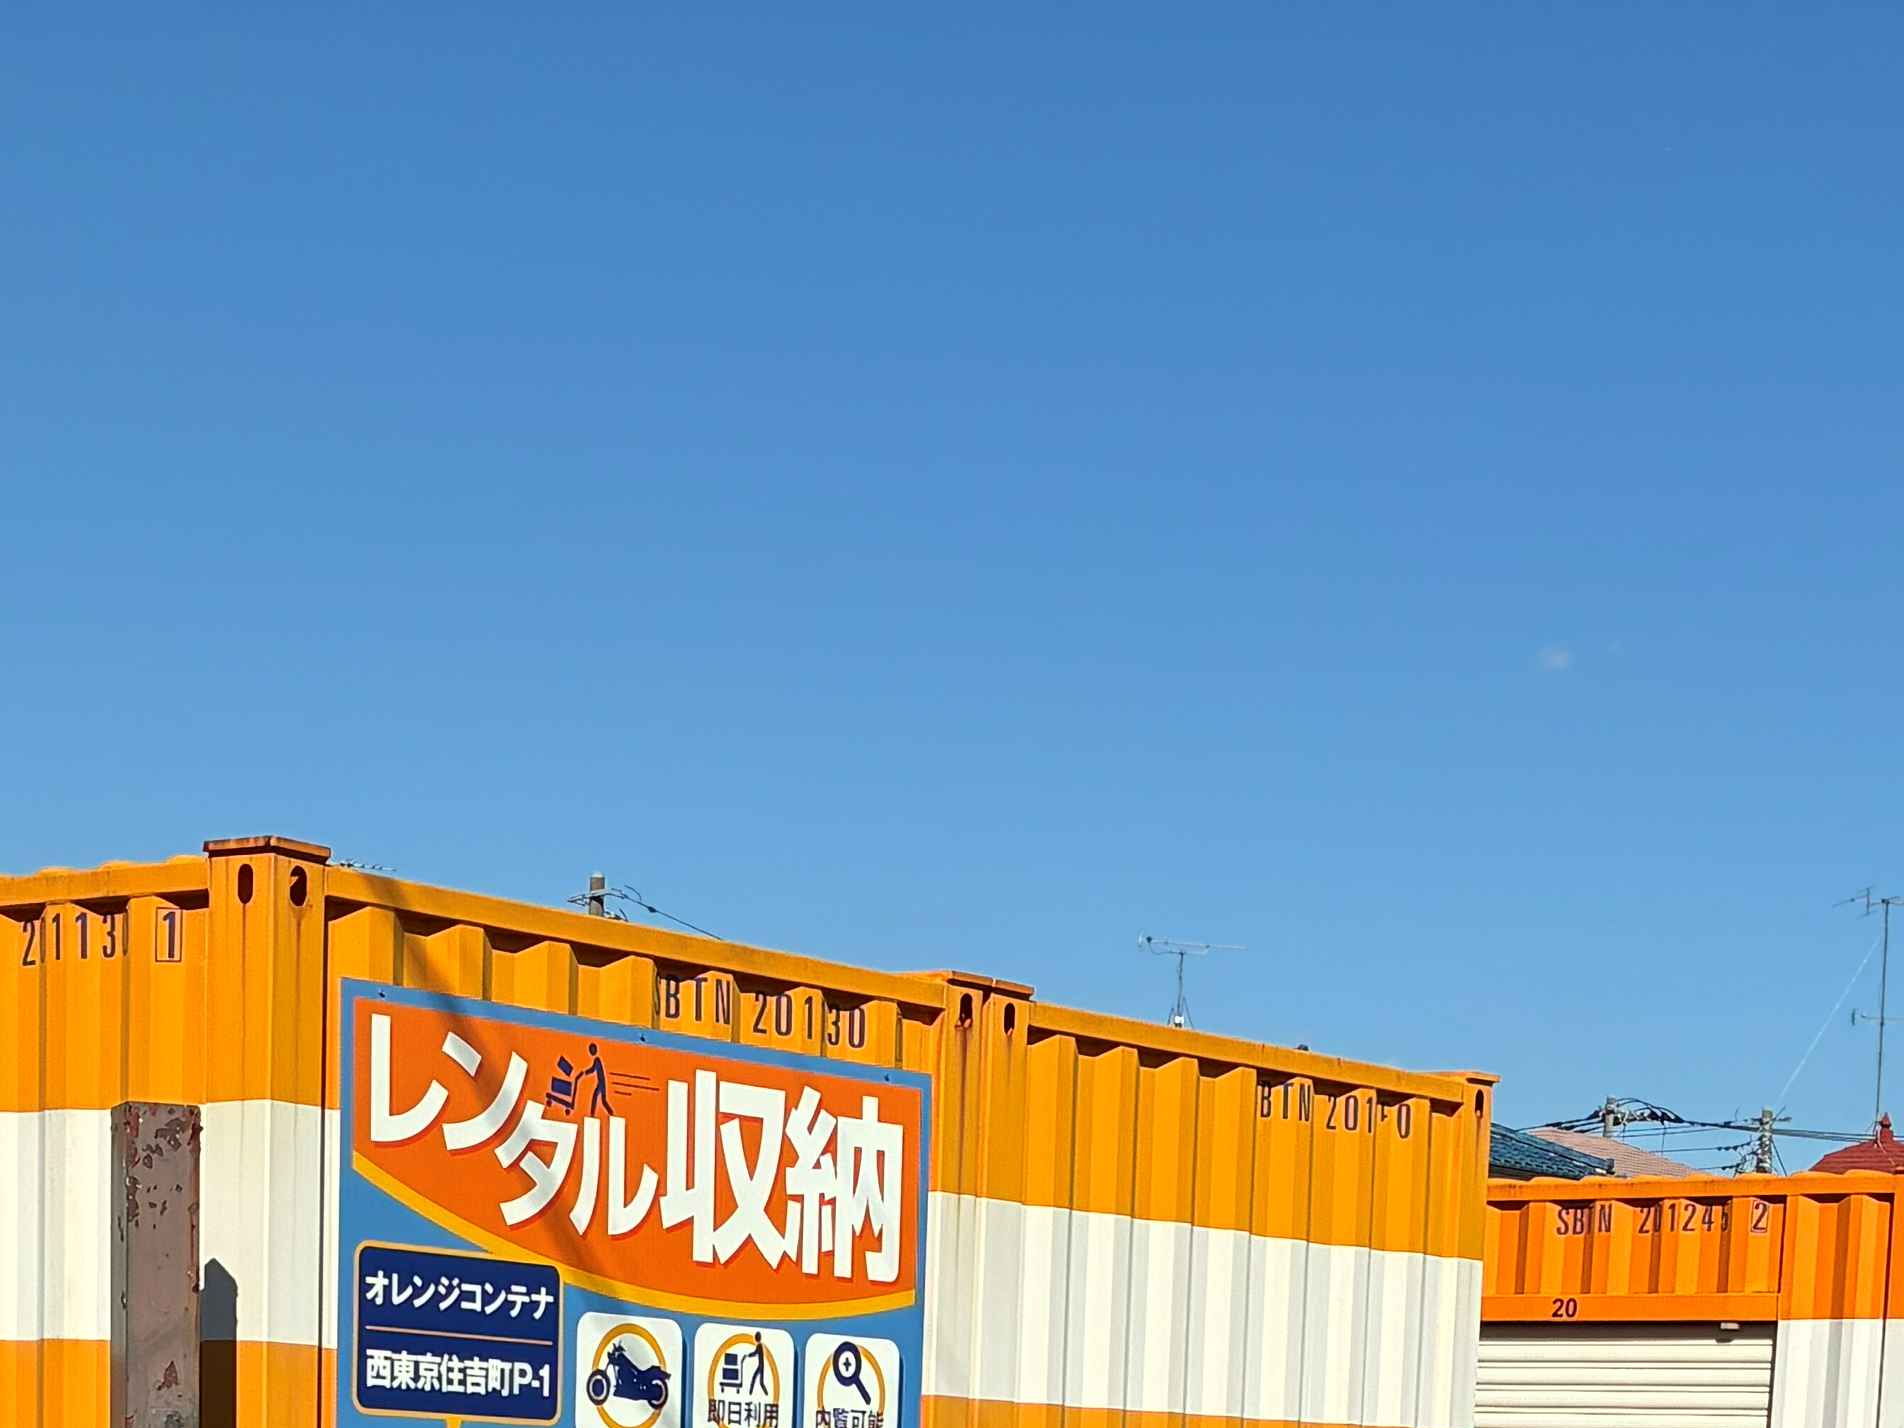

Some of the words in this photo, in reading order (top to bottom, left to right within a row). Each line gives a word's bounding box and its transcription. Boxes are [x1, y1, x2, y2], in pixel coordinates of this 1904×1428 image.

[369, 1012, 905, 1285] レンタル収納
[364, 1269, 555, 1320] オレンジコンテナ
[1550, 1297, 1579, 1319] 20
[365, 1348, 551, 1398] 西東京住吉町P-1
